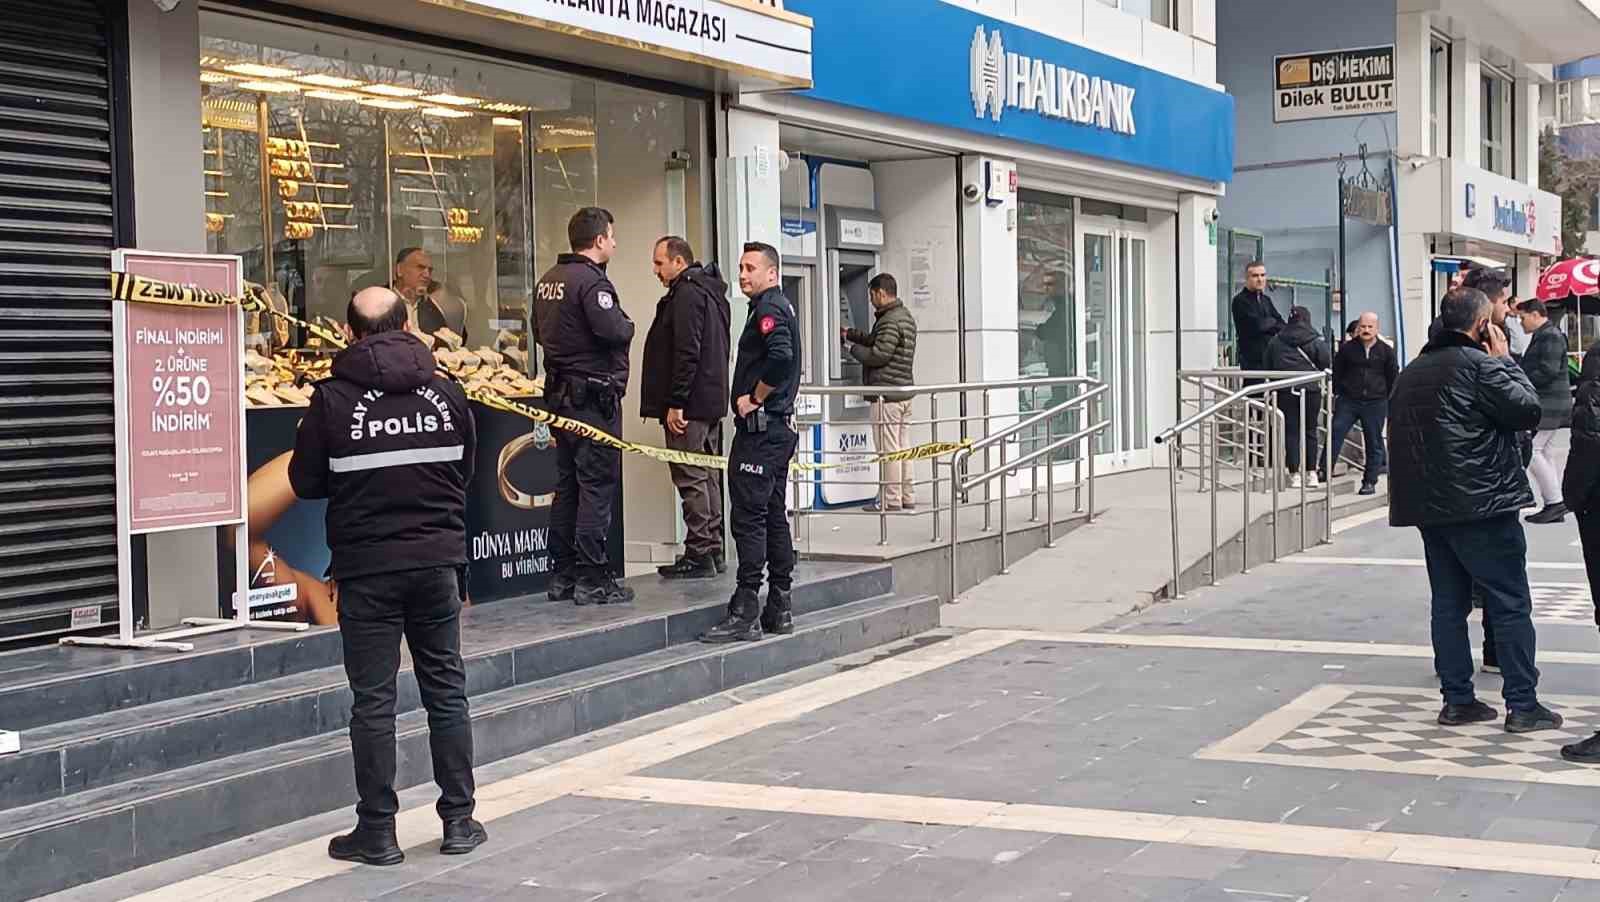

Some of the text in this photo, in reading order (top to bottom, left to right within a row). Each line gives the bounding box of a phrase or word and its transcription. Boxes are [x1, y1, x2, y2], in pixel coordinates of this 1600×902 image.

[1312, 54, 1391, 85] DİŞ HEKİMİ
[1006, 51, 1136, 136] HALKBANK
[1280, 83, 1393, 108] Dilek BULUT
[136, 327, 223, 345] FİNAL İNDİRİMİ
[167, 355, 208, 372] ÜRÜNE
[152, 375, 210, 407] %50
[351, 401, 368, 440] OLAY
[368, 411, 438, 438] POLİS
[850, 433, 867, 448] TAM
[473, 531, 511, 560] DÜNYA
[501, 562, 513, 578] BU
